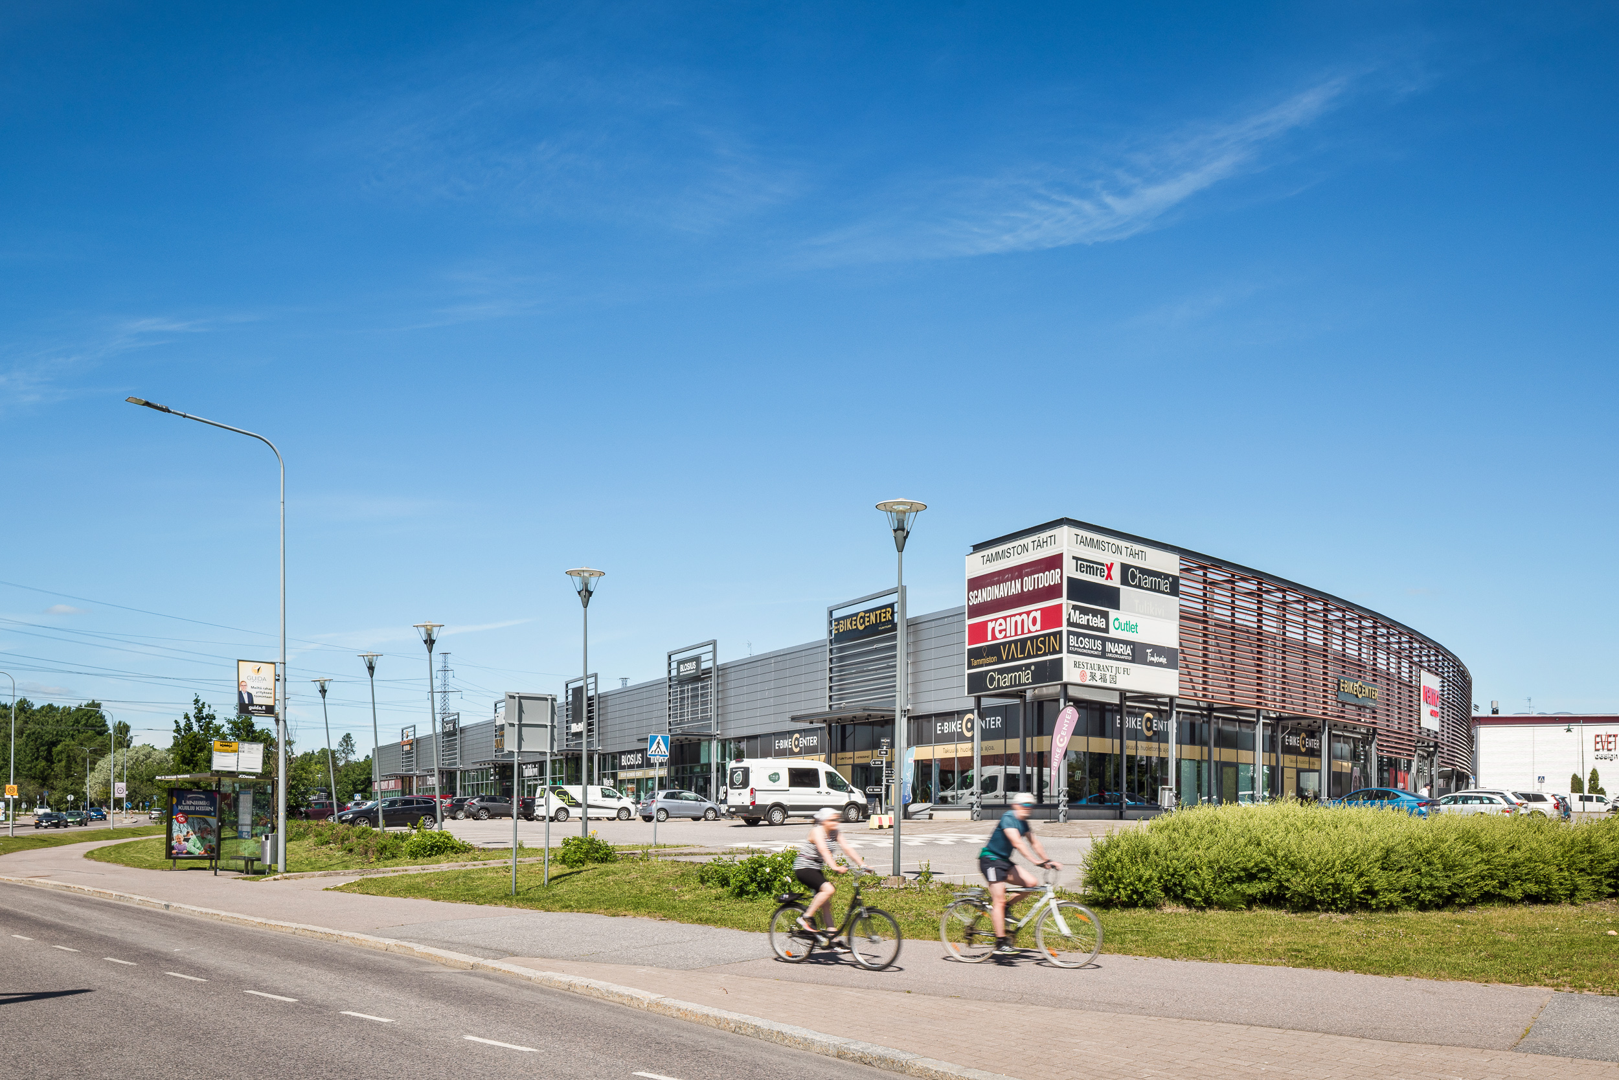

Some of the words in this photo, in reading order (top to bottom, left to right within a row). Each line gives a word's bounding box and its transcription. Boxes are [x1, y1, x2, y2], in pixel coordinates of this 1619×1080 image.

[981, 542, 1028, 565] TAMMISTON
[1031, 534, 1056, 552] TÄHTI
[1074, 534, 1122, 556] TAMMISTON
[1124, 545, 1146, 562] TÄHTI
[968, 578, 1021, 606] SCANDINAVIAN
[1022, 568, 1061, 592] OUTDOOR
[988, 610, 1041, 640] reima
[1070, 610, 1106, 628] Martela
[1113, 617, 1138, 634] Outlet
[970, 656, 997, 666] Tammiston
[1000, 634, 1059, 660] VALAISIN
[1069, 635, 1102, 651] BLOSIUS
[1074, 661, 1113, 673] RESTAURANT
